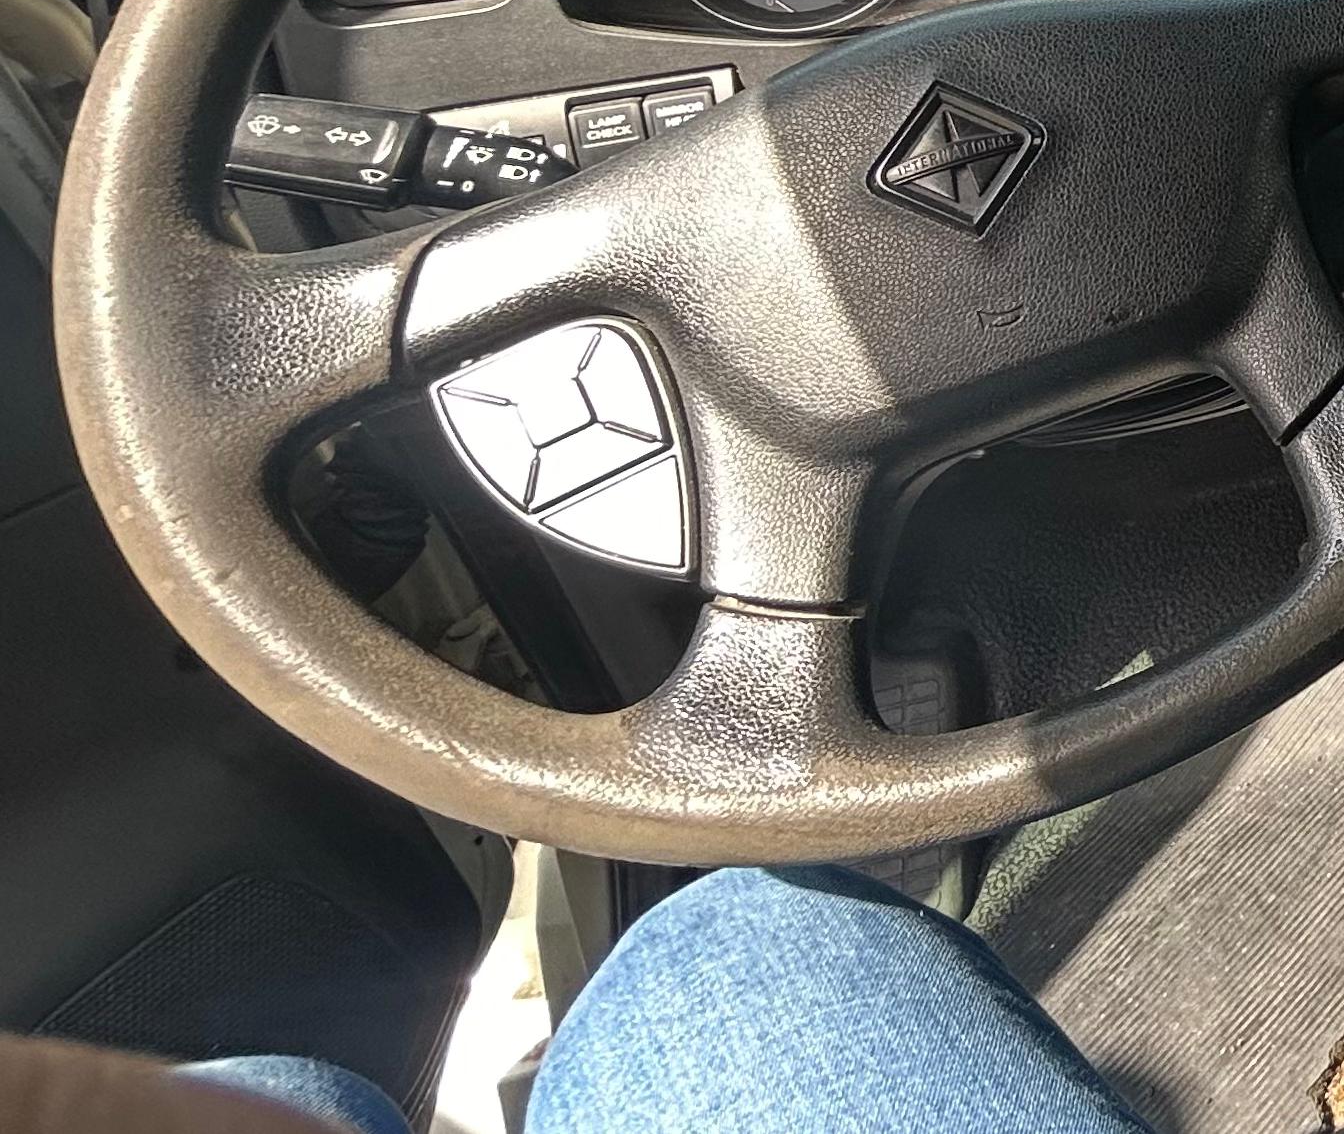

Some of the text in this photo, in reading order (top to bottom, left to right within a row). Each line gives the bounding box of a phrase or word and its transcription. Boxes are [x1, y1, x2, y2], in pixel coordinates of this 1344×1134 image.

[655, 101, 705, 118] MIRROR
[588, 114, 626, 129] LAMP
[665, 114, 697, 128] HE
[586, 124, 633, 140] CHECK
[897, 134, 1014, 176] INTERNATIONAL
